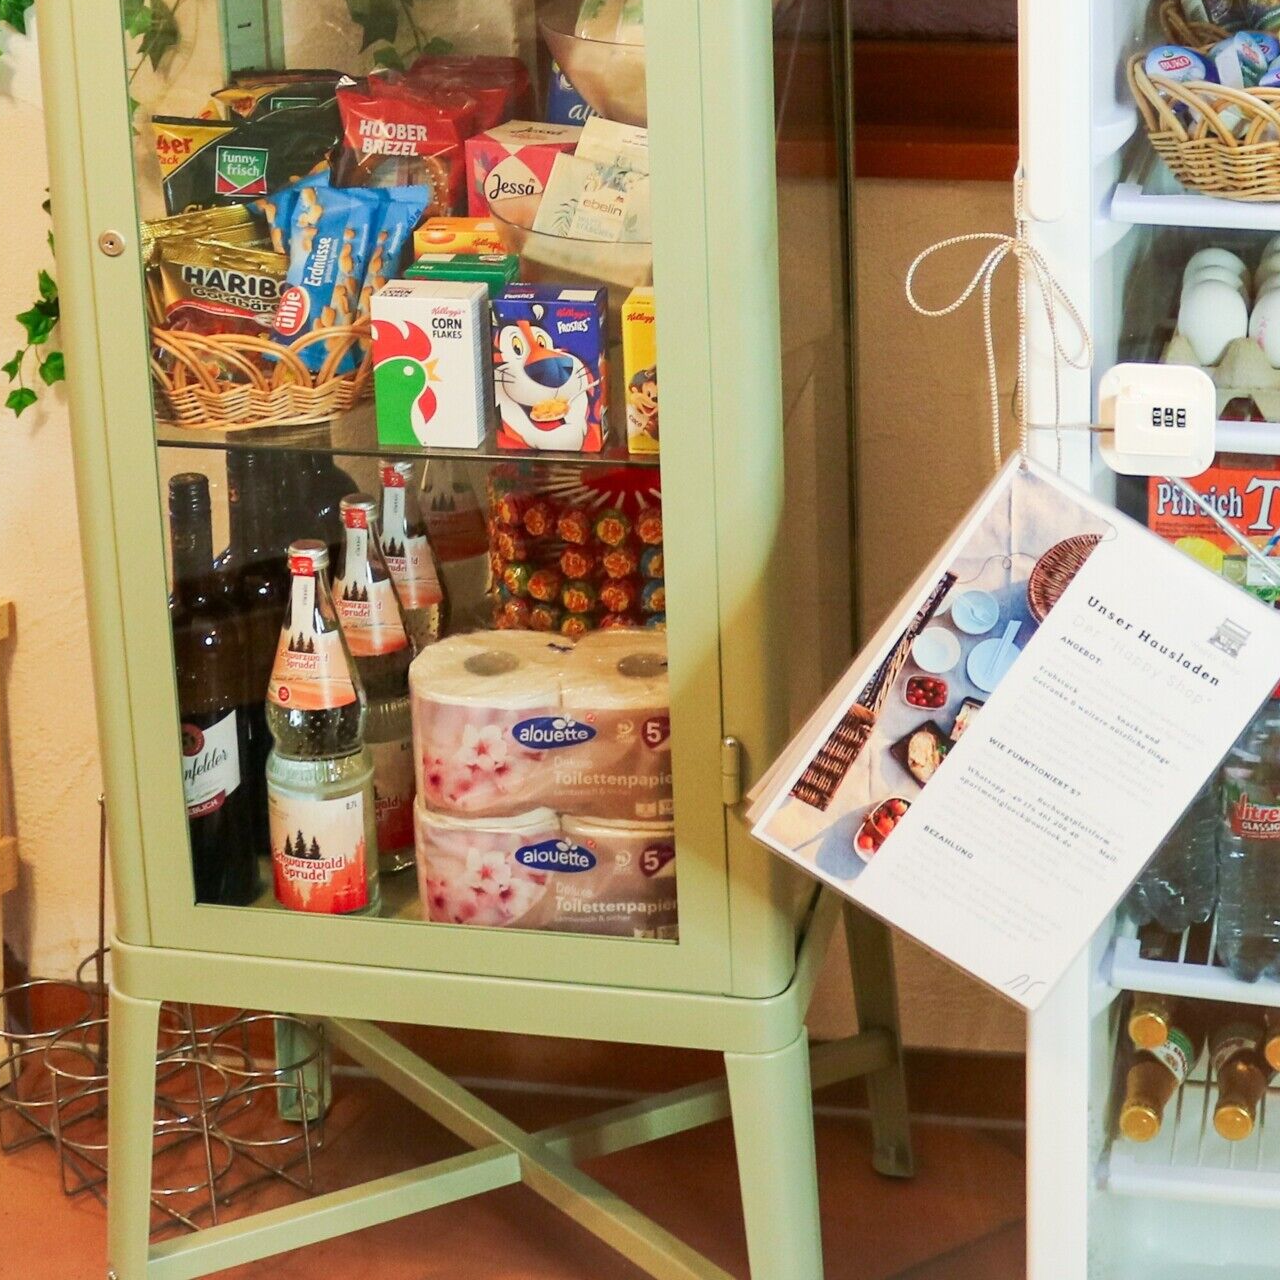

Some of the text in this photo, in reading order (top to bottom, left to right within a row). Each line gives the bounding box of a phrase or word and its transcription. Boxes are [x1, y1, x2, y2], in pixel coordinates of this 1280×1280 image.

[1160, 57, 1190, 70] BUKO
[156, 134, 194, 154] 4er
[362, 137, 419, 157] BREZEL
[222, 150, 259, 164] funny-
[227, 165, 260, 177] frisch
[488, 173, 535, 200] Jessa
[582, 197, 623, 217] ebelin
[303, 236, 332, 287] Erdnüsse
[192, 286, 282, 313] Goldbäre
[431, 317, 463, 330] CORN
[626, 312, 656, 324] Kellogg
[432, 329, 463, 340] FLAKES
[1086, 595, 1221, 688] Unser Hausladen
[520, 724, 589, 743] alouette
[646, 721, 662, 743] 5
[987, 735, 1006, 751] WIE
[184, 747, 228, 786] nfelder
[554, 770, 673, 789] Toilettenpapie
[1241, 821, 1280, 832] CLASSIC
[523, 847, 590, 868] alouette
[644, 850, 660, 870] 5
[284, 863, 327, 882] Sprudel
